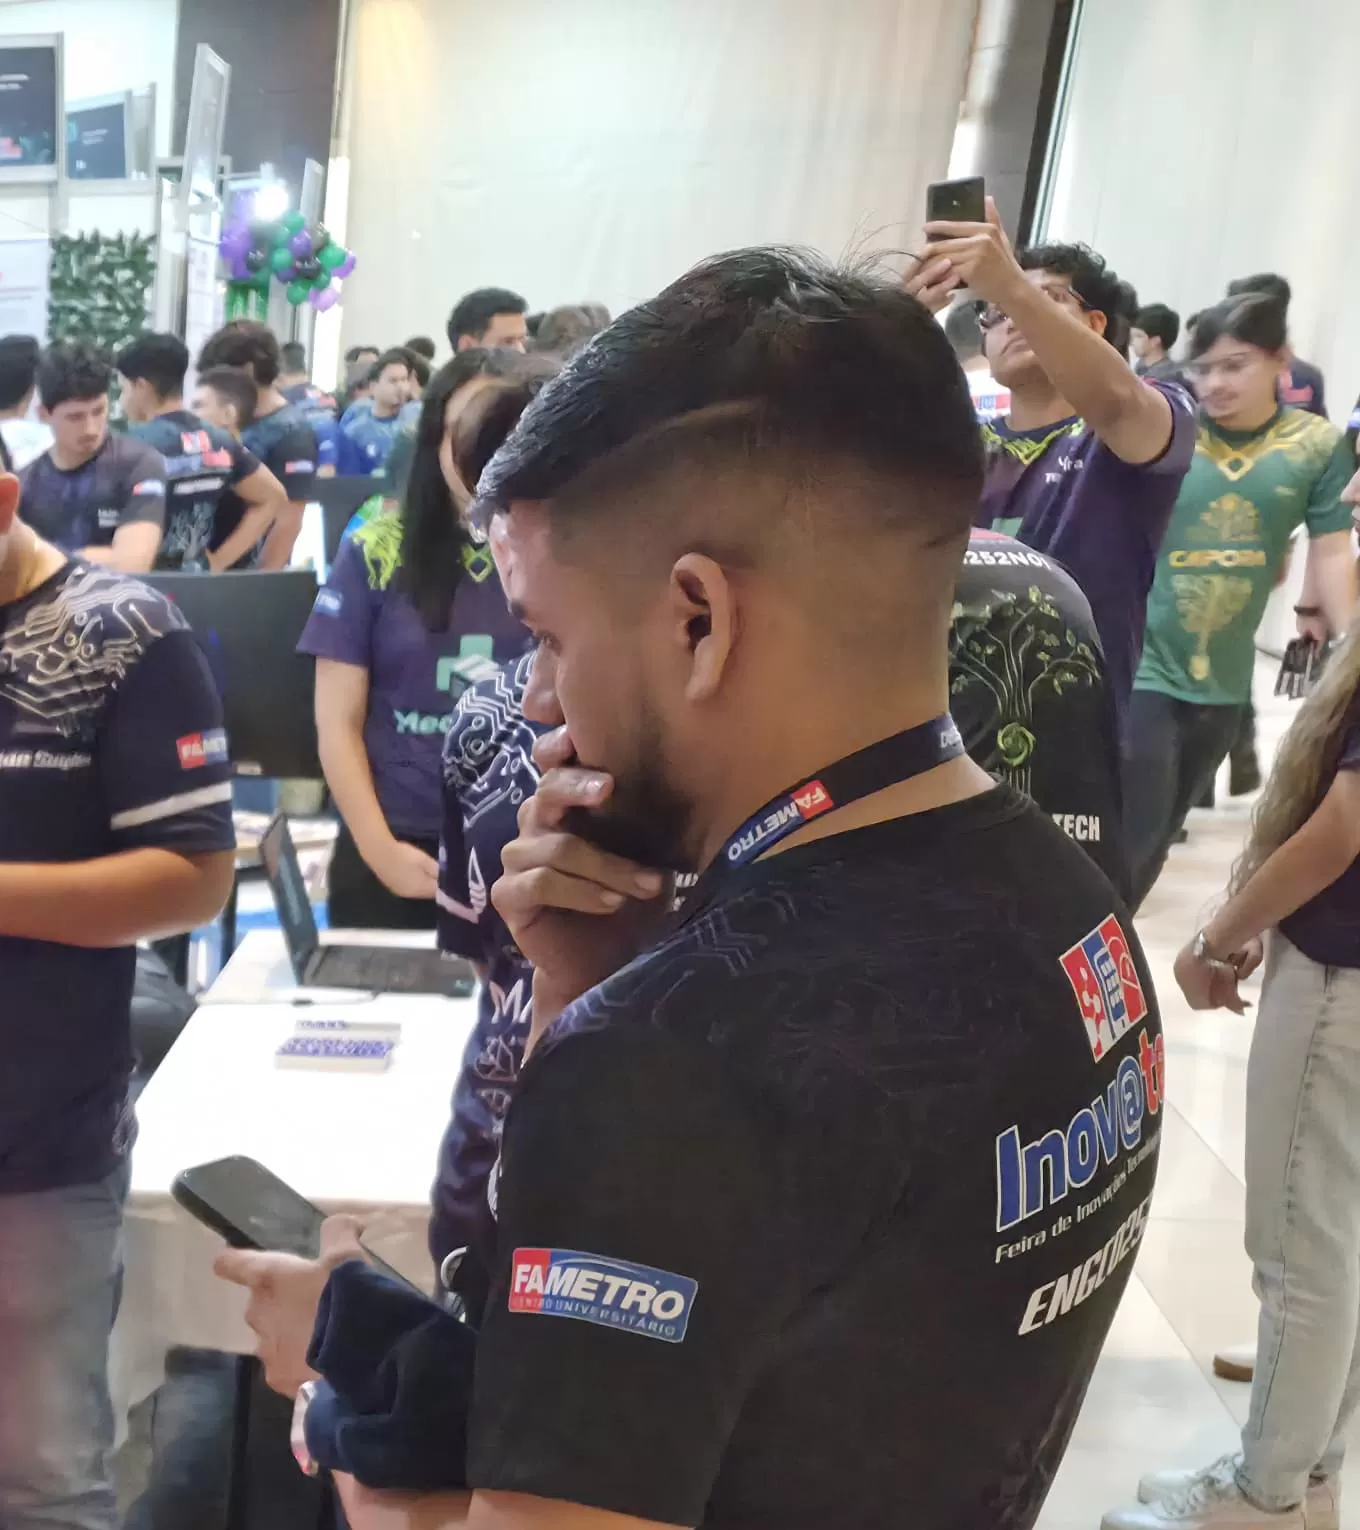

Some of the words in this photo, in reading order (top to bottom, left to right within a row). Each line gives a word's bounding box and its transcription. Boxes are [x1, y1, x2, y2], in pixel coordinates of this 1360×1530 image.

[727, 783, 830, 862] FAMETRO
[995, 1228, 1046, 1264] Feira
[1051, 1216, 1073, 1238] de
[514, 1263, 685, 1321] FAMETRO
[555, 1298, 677, 1337] UNIVERSITÁRIO
